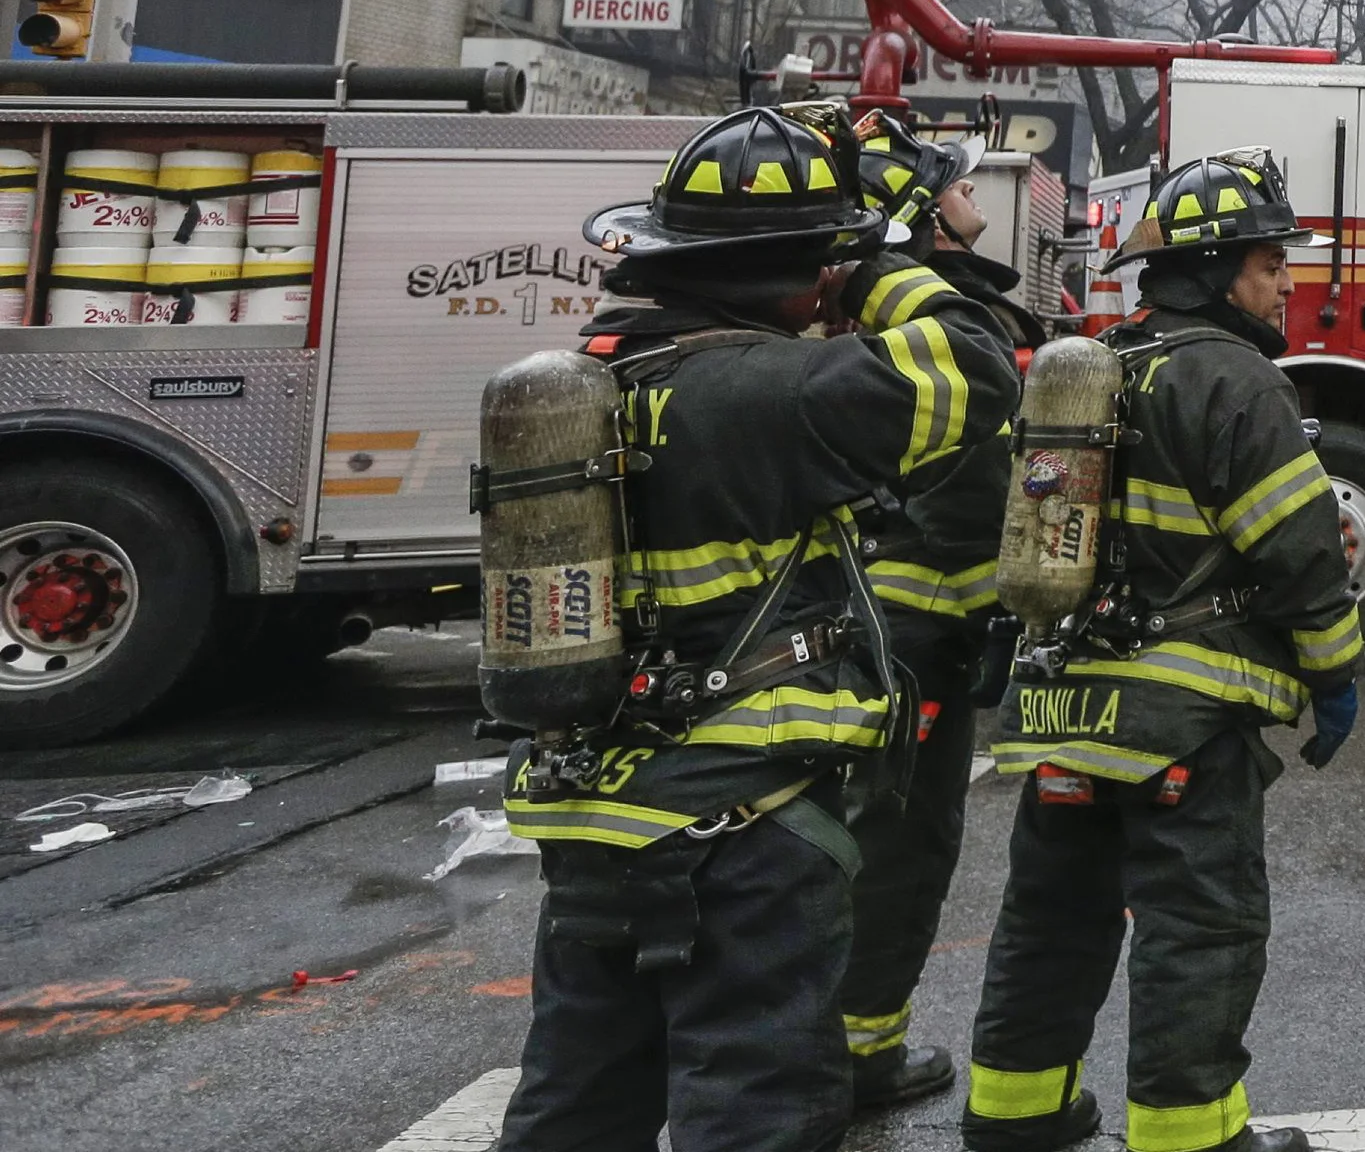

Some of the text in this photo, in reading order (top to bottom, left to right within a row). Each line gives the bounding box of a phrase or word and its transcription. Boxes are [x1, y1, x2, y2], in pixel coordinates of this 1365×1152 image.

[572, 0, 670, 22] PIERCING
[406, 242, 617, 298] SATELLIT
[1060, 505, 1085, 565] SCOTT
[506, 573, 533, 648] SCOTT
[550, 583, 561, 637] AIR-PAK
[1019, 687, 1121, 735] BONILLA
